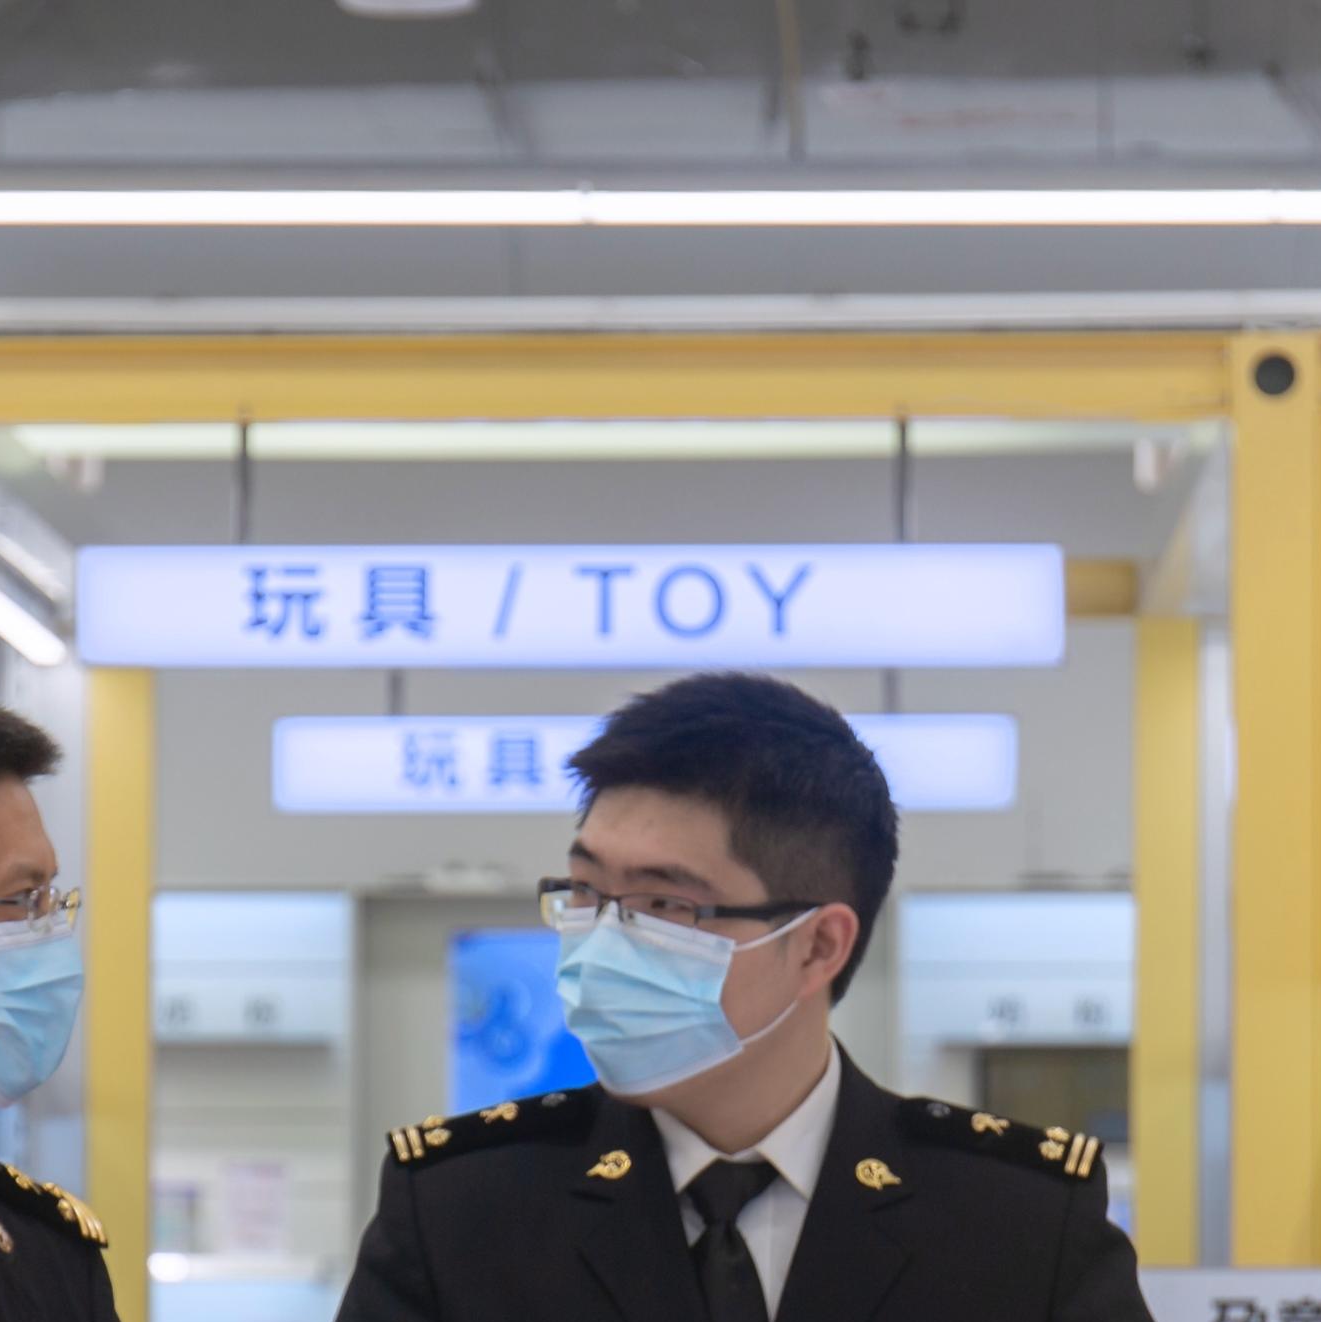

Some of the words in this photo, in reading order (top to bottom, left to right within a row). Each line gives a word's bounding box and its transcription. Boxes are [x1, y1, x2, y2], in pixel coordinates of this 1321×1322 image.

[243, 563, 435, 641] 玩具
[574, 562, 813, 640] TOY
[401, 730, 544, 788] 玩具
